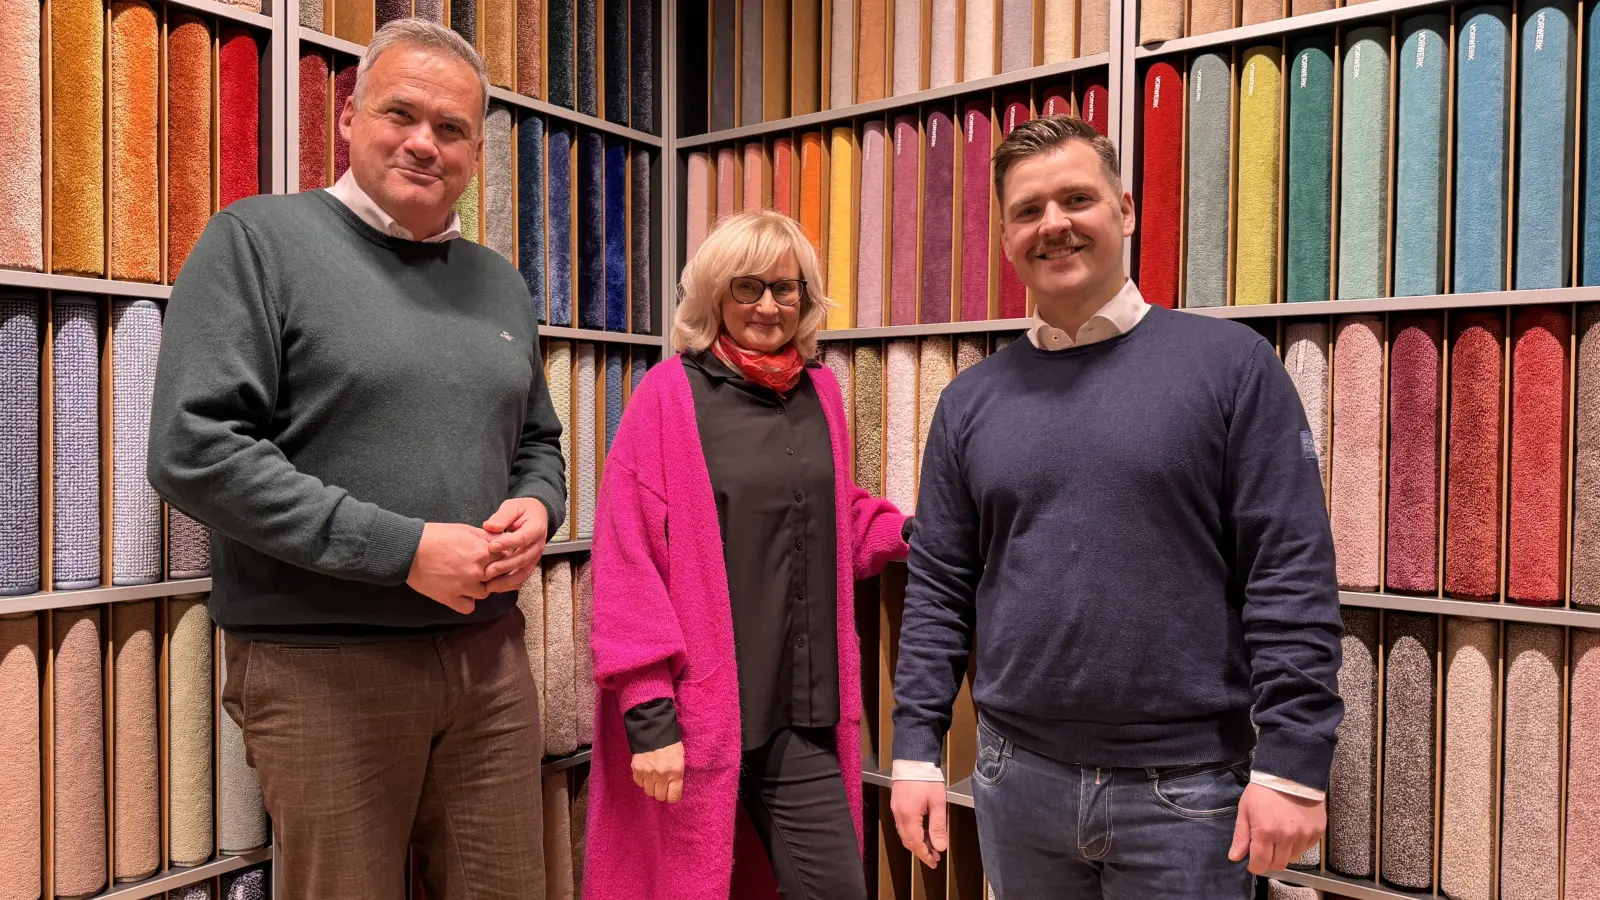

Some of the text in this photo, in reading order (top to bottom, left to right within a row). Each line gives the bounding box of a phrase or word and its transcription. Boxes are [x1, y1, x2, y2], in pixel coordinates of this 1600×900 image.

[1416, 31, 1426, 69] VORWERK
[1467, 23, 1477, 61] VORWERK
[1535, 12, 1545, 51] VORWERK
[1248, 62, 1256, 96] VORWERK
[1300, 53, 1308, 88] VORWERK
[1353, 43, 1361, 80] VORWERK
[1153, 75, 1161, 108] VORWERK
